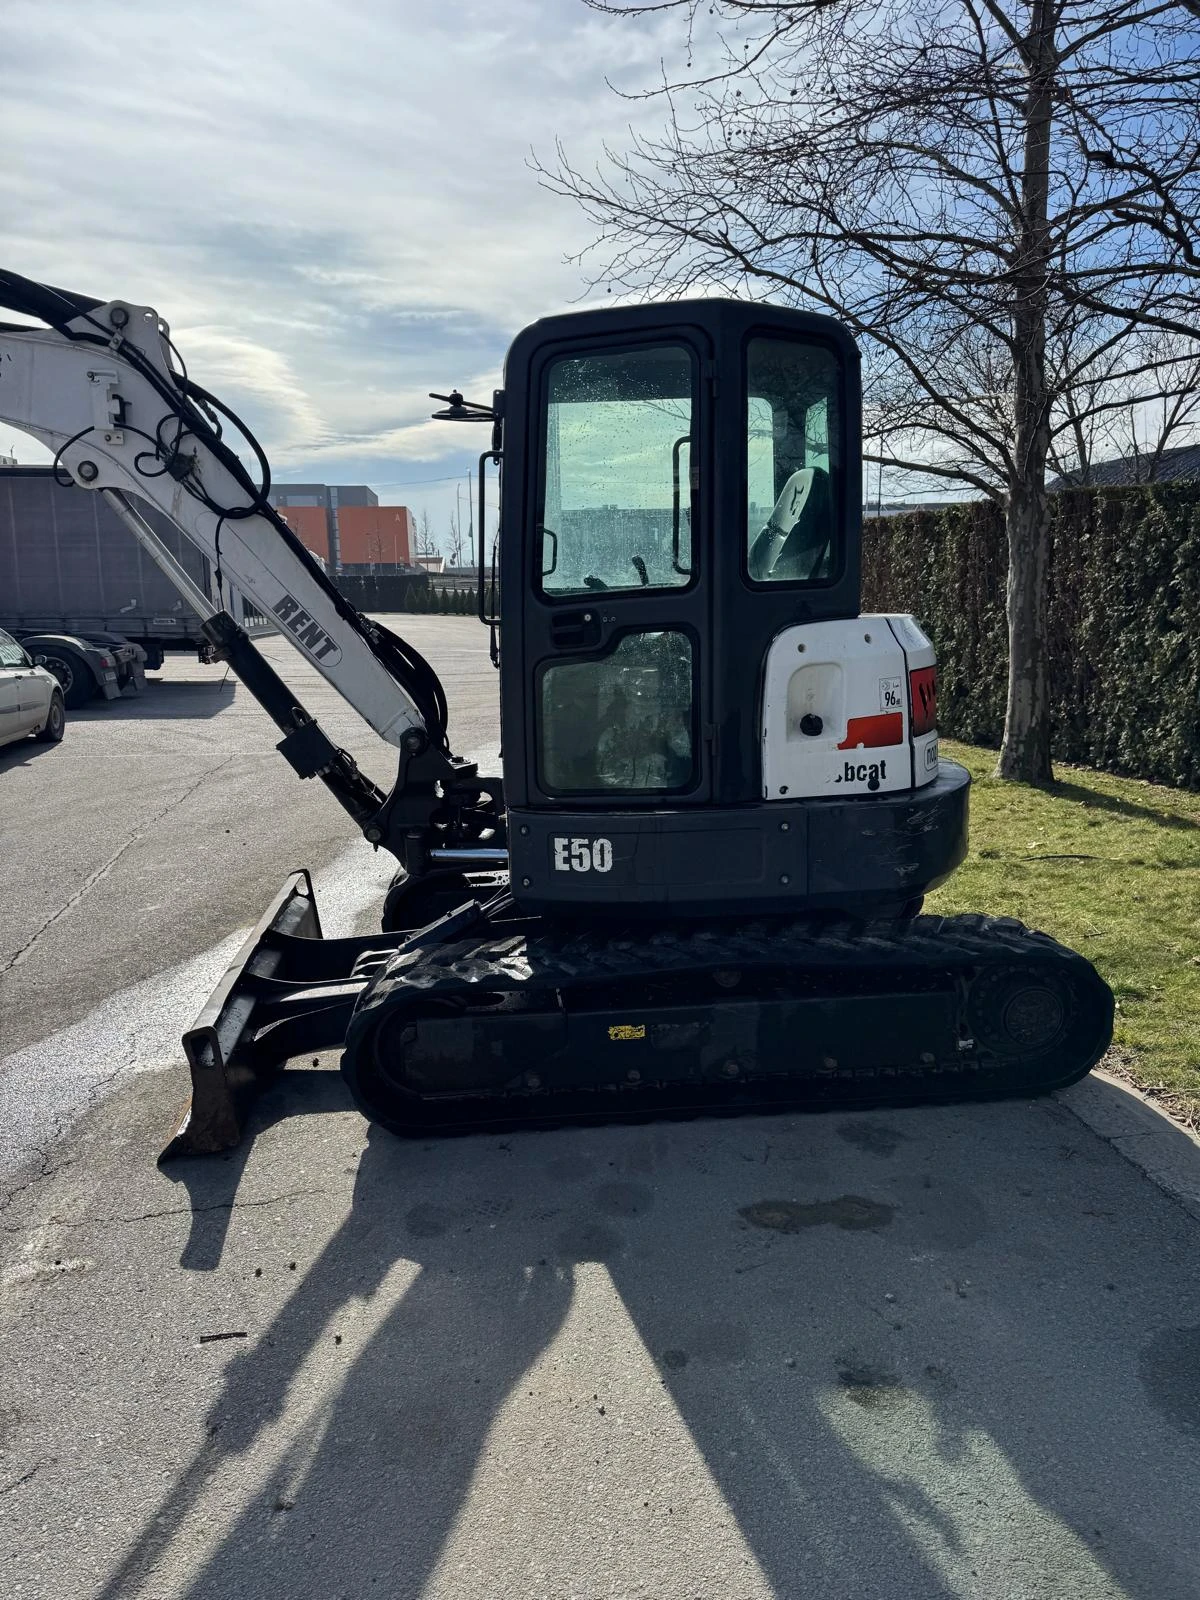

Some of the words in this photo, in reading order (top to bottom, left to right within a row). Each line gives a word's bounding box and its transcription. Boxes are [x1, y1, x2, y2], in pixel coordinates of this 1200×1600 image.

[272, 594, 339, 660] RENT
[885, 691, 896, 706] 96
[834, 760, 887, 783] bcat
[554, 837, 613, 873] E50
